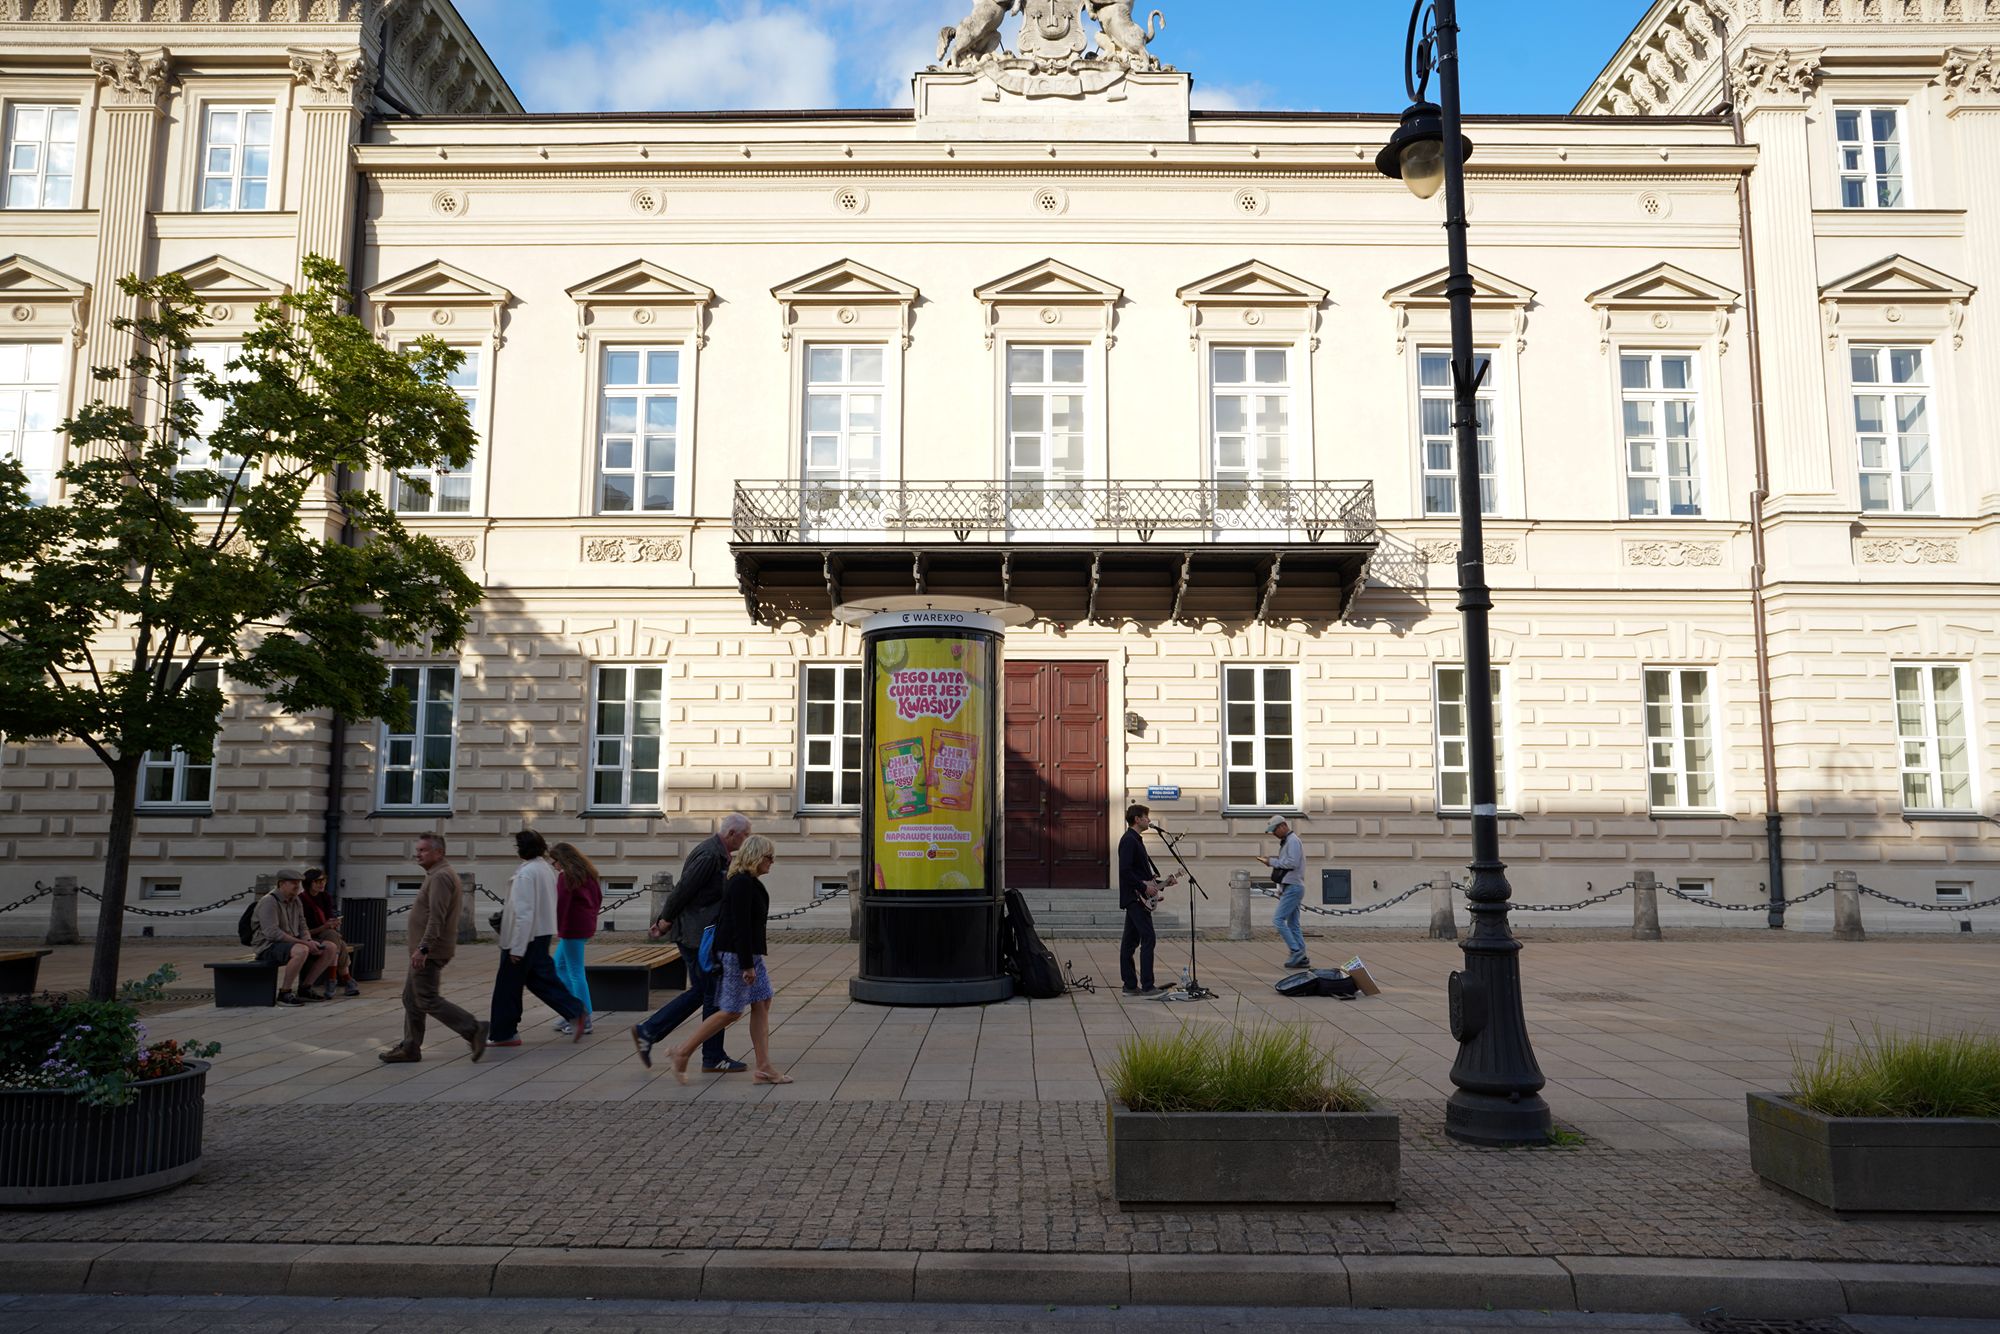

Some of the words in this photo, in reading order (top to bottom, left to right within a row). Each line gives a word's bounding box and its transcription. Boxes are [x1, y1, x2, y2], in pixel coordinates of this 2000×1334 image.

[913, 613, 964, 622] WAREXPO
[894, 671, 929, 683] TEGO
[931, 671, 965, 684] LATA
[889, 685, 937, 697] CUKIER
[939, 685, 969, 697] JEST
[898, 697, 961, 719] KWAŚNY
[886, 833, 931, 842] NAPRAWDĘ
[933, 831, 970, 840] KWAŚNE!
